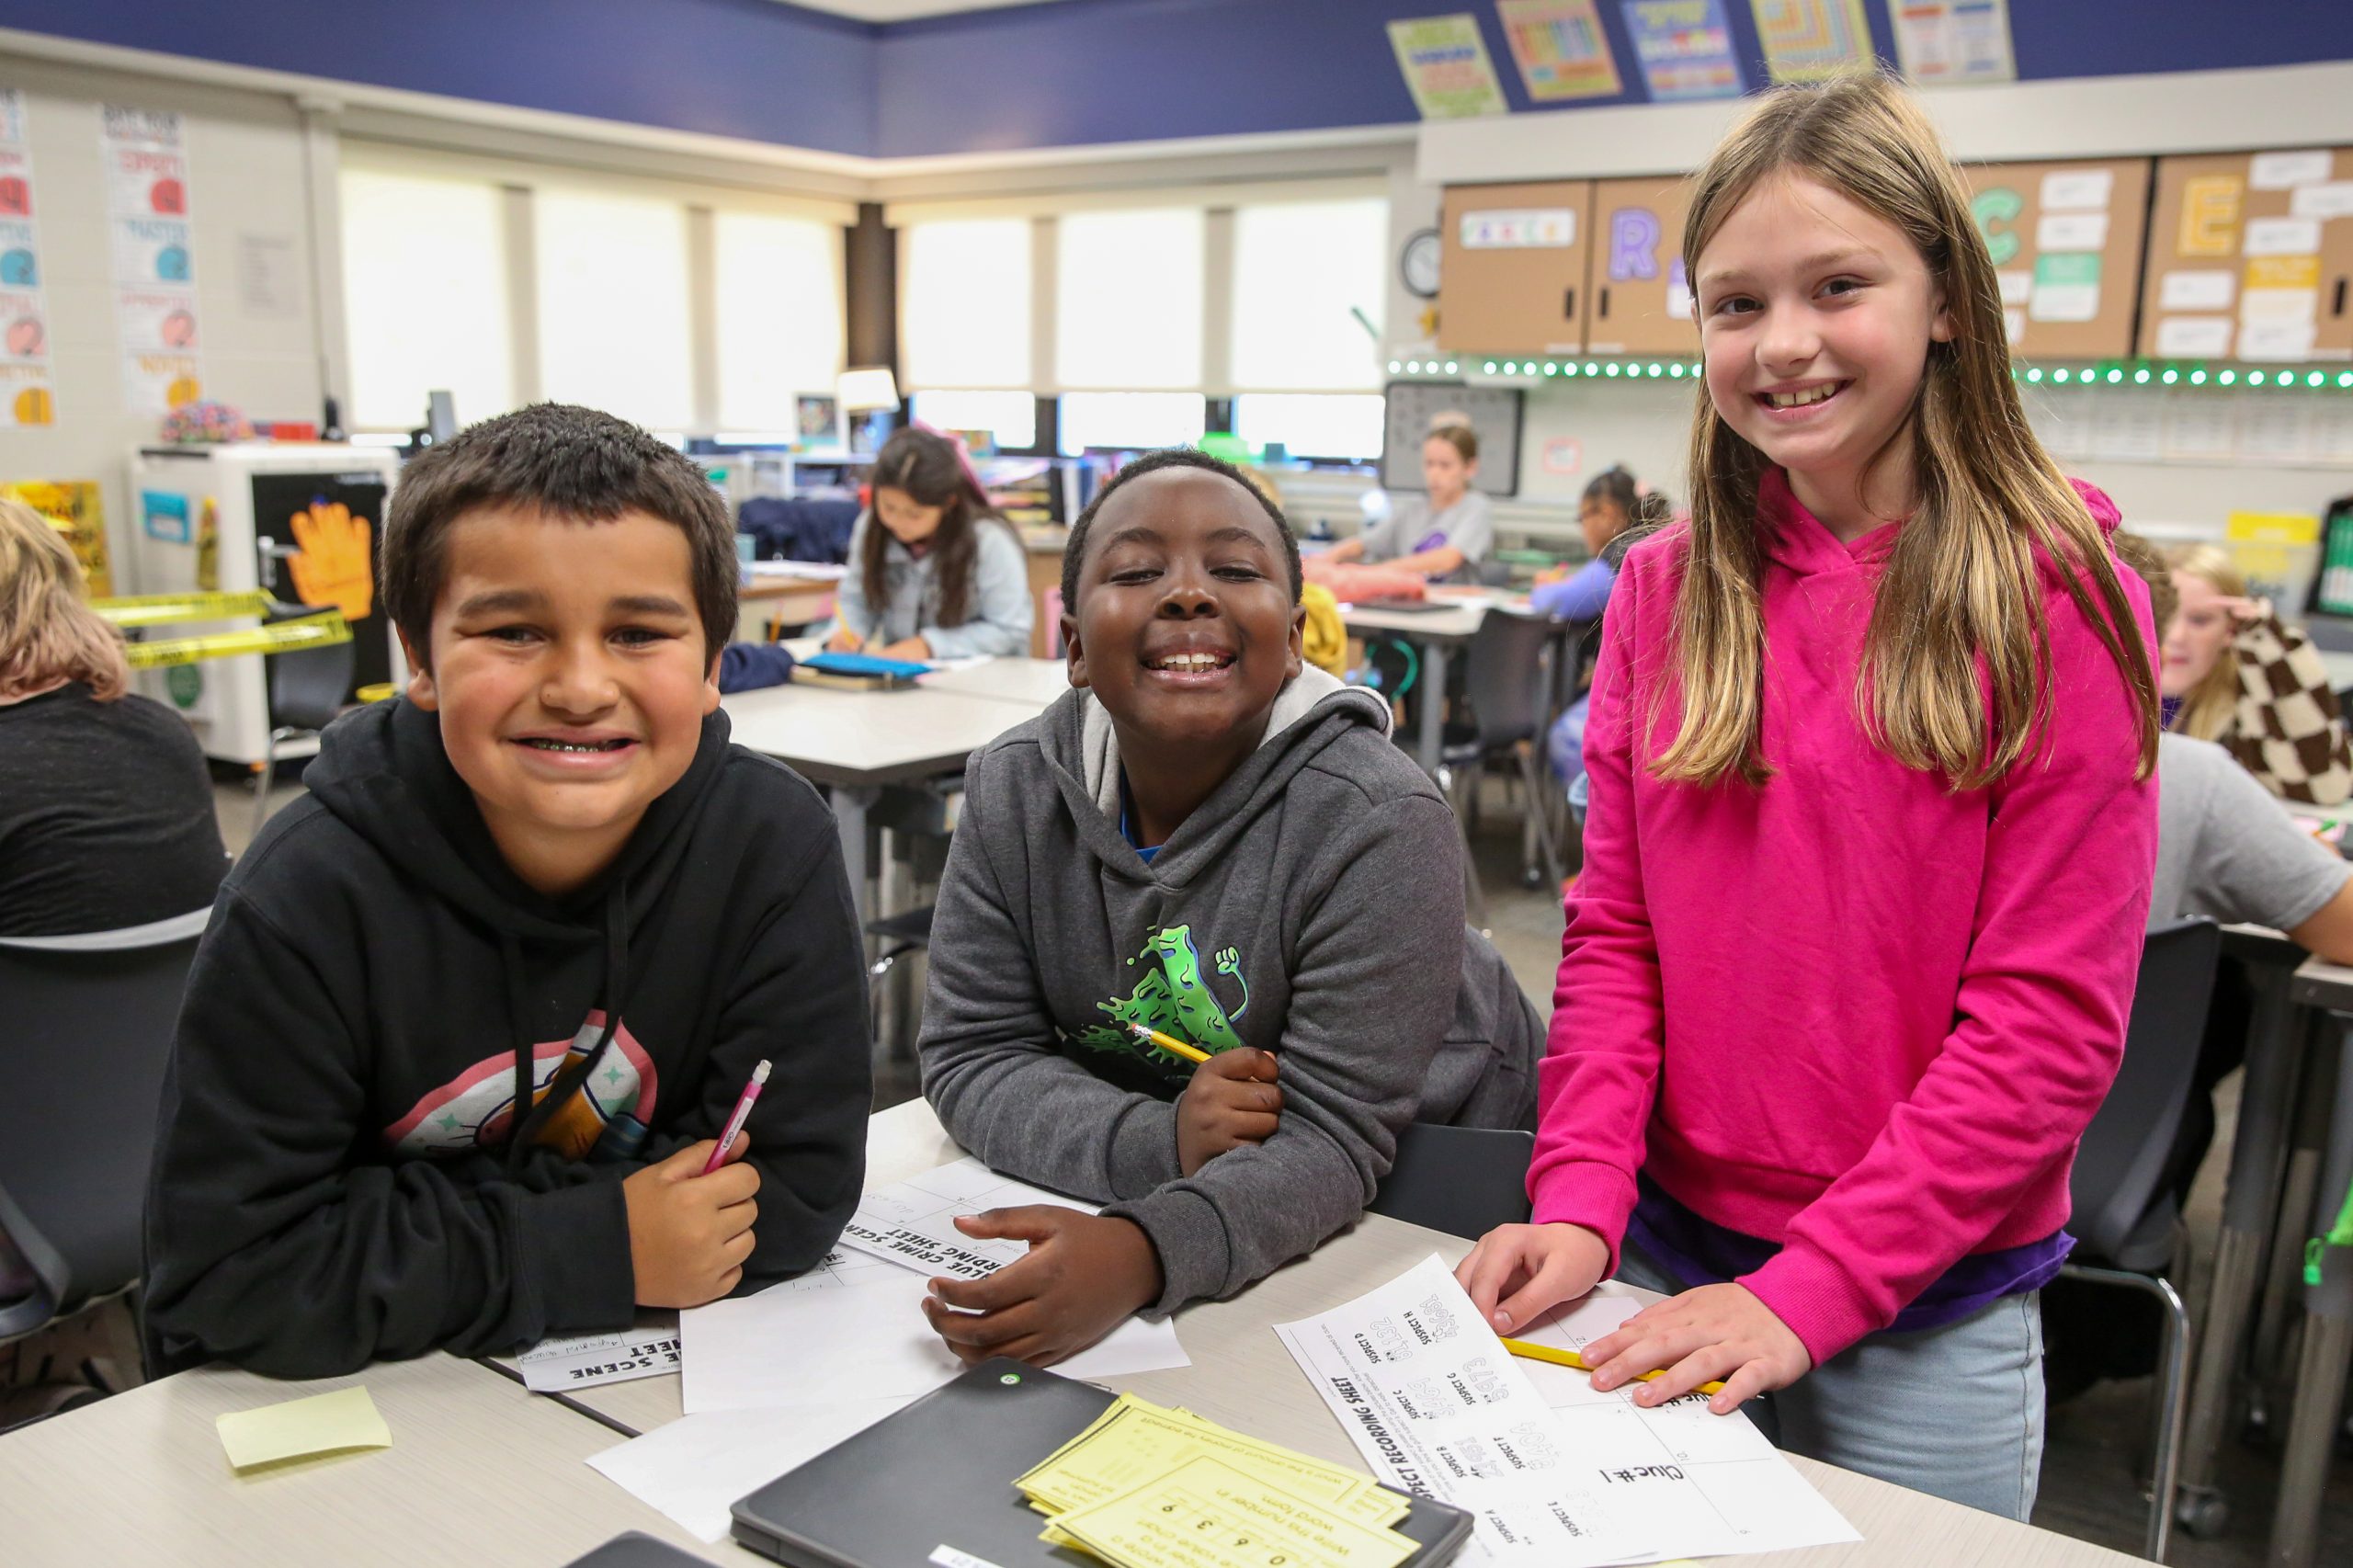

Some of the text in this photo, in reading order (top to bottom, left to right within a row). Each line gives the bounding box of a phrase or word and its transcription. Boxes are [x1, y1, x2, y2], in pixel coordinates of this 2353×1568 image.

[1972, 187, 2025, 266] C
[2177, 175, 2246, 258] E
[1608, 207, 1660, 281] R
[845, 1223, 888, 1243] SCEN
[884, 1228, 941, 1250] SHEET
[888, 1241, 939, 1264] CRIME
[941, 1247, 1001, 1272] RDING
[1404, 1311, 1432, 1346] SUSPECT H
[630, 1338, 681, 1360] HEET
[1358, 1338, 1381, 1364] SUSPECT
[569, 1357, 654, 1380] SCENE
[1331, 1377, 1365, 1404] SHEET
[1451, 1381, 1476, 1405] SUSPECT
[1397, 1392, 1421, 1419] SUSPECT
[1352, 1406, 1409, 1464] RECORDING
[1440, 1452, 1467, 1478] SUSPECT
[1498, 1441, 1526, 1470] SUSPECT
[1216, 1488, 1231, 1497] in
[1162, 1504, 1177, 1513] 9
[1231, 1496, 1286, 1524] number
[1295, 1511, 1334, 1531] word
[1197, 1520, 1213, 1529] 3
[1288, 1521, 1311, 1537] this
[1490, 1517, 1518, 1544] SUSPECT
[1552, 1509, 1583, 1538] SUSPECT
[1233, 1538, 1249, 1547] 6
